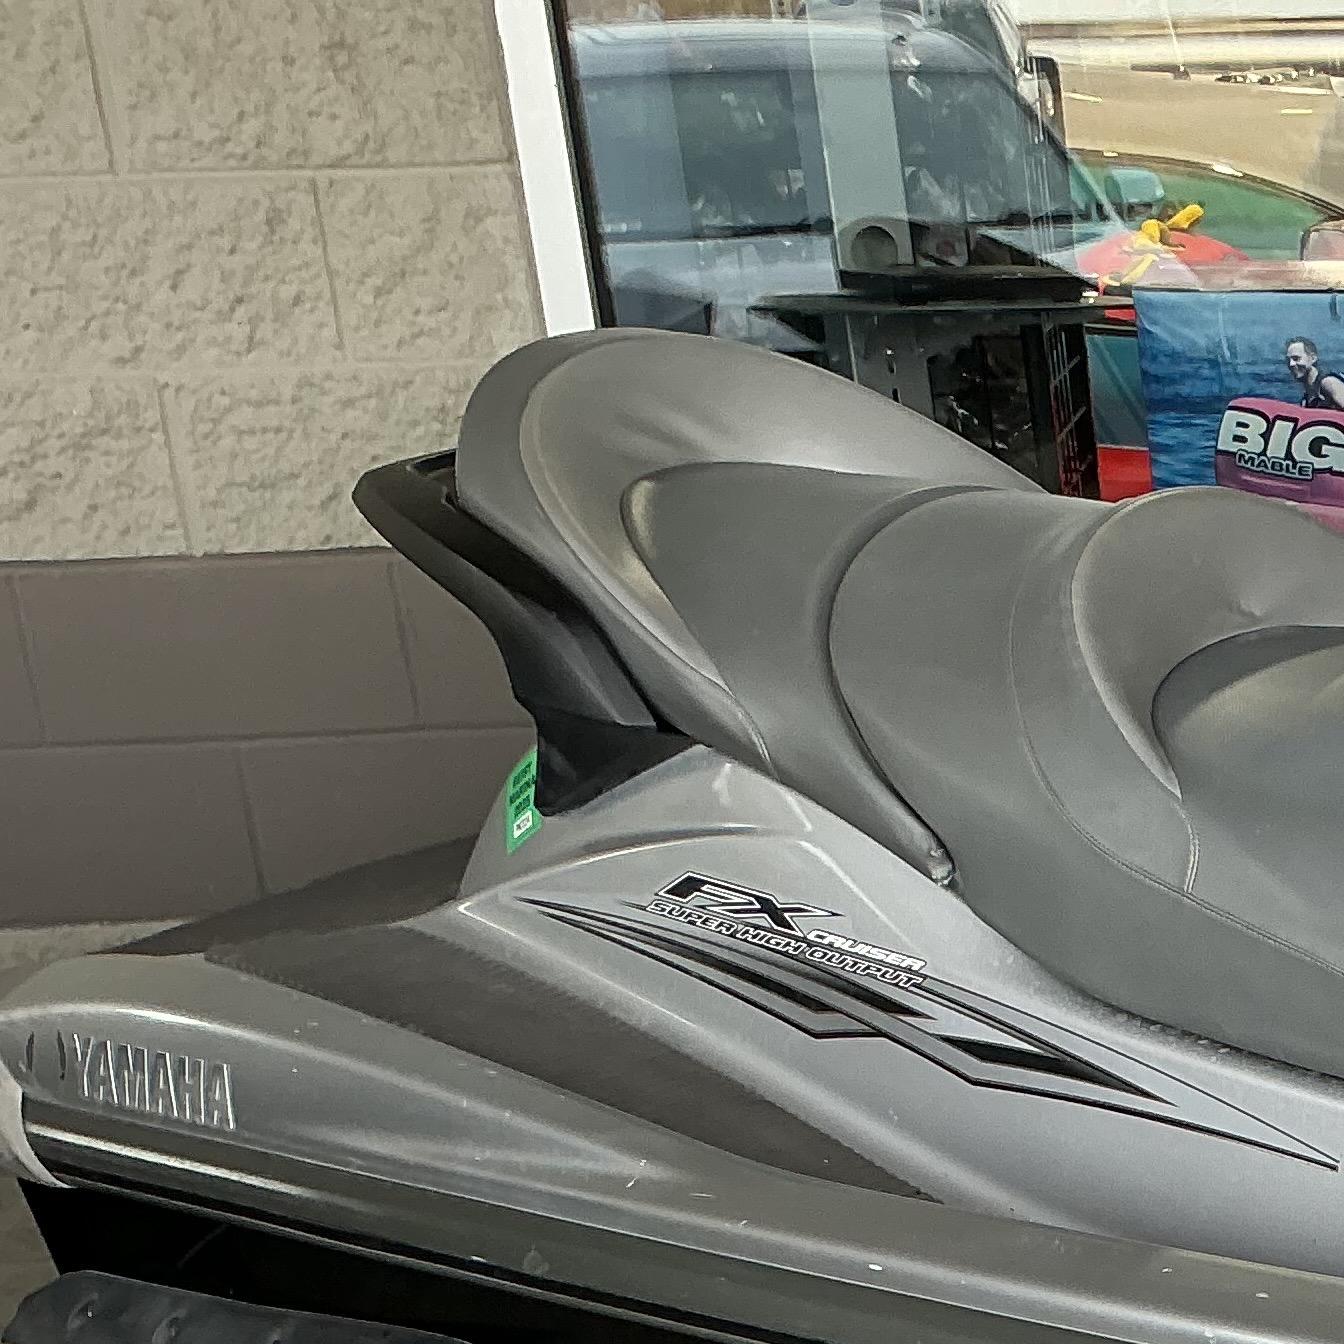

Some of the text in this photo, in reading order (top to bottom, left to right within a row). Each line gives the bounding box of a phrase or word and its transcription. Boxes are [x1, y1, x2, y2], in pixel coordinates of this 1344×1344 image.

[1236, 451, 1314, 480] MABLE
[655, 871, 846, 937] FX
[646, 899, 925, 989] SUPER HIGH OUTPUT
[805, 928, 927, 972] CRUISER
[72, 1031, 237, 1130] YAMAHA
